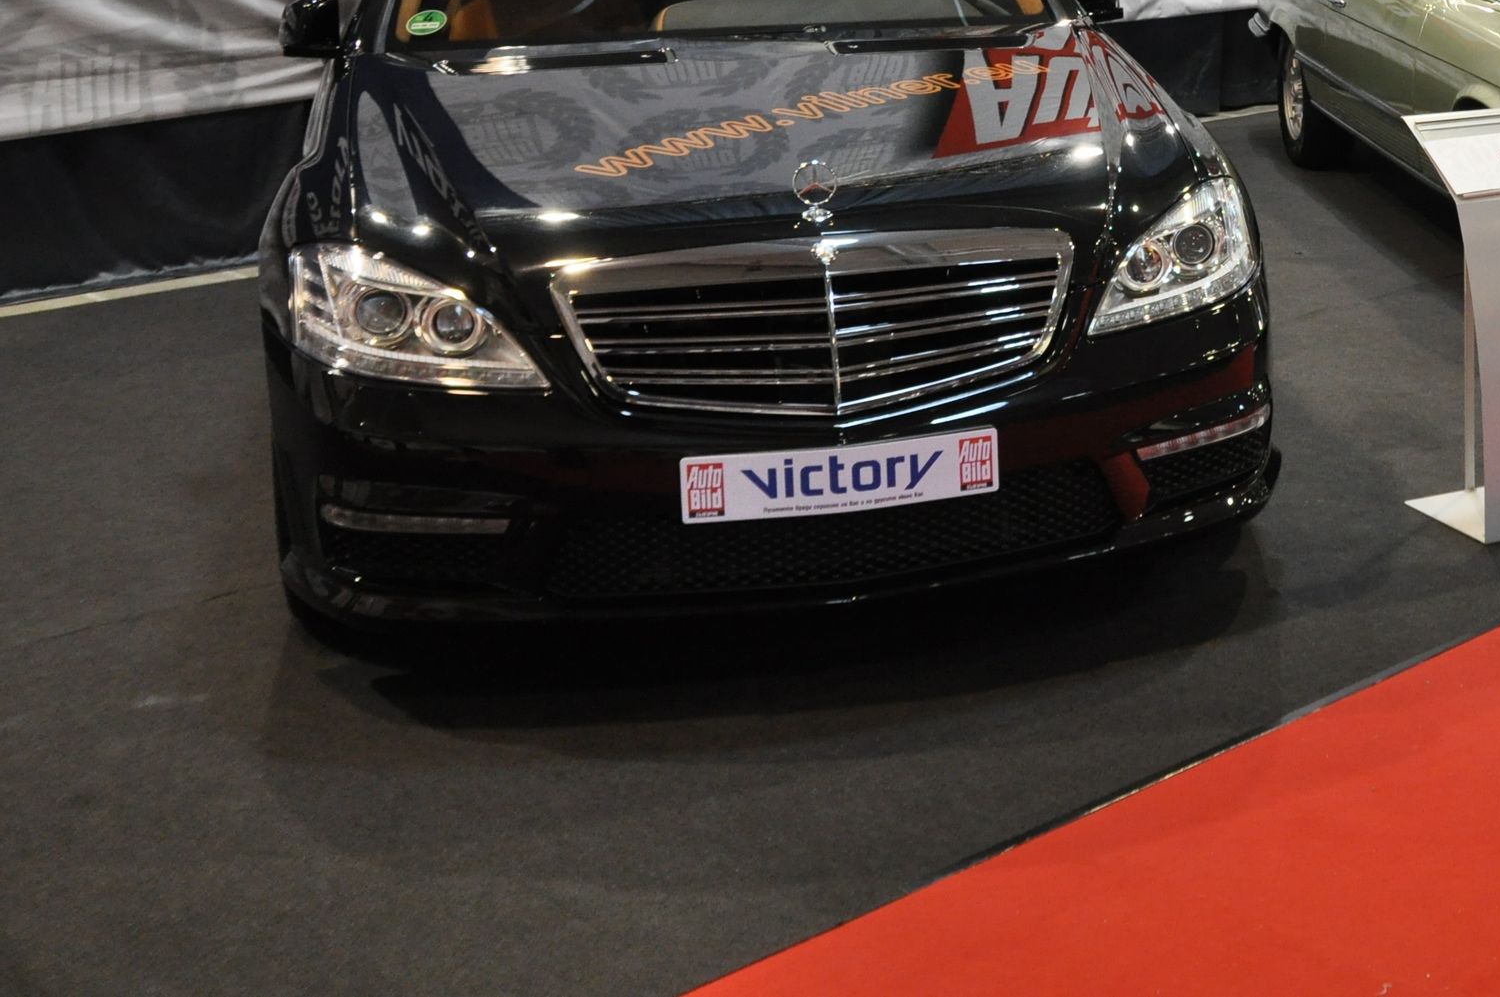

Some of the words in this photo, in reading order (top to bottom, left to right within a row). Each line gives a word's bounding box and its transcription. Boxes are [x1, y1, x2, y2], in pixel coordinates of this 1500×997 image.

[574, 61, 1050, 178] www.vilner.eu
[959, 439, 991, 463] Auto
[687, 465, 722, 490] Auto
[741, 450, 944, 499] victory
[962, 461, 991, 484] Bild
[690, 489, 723, 511] Bild
